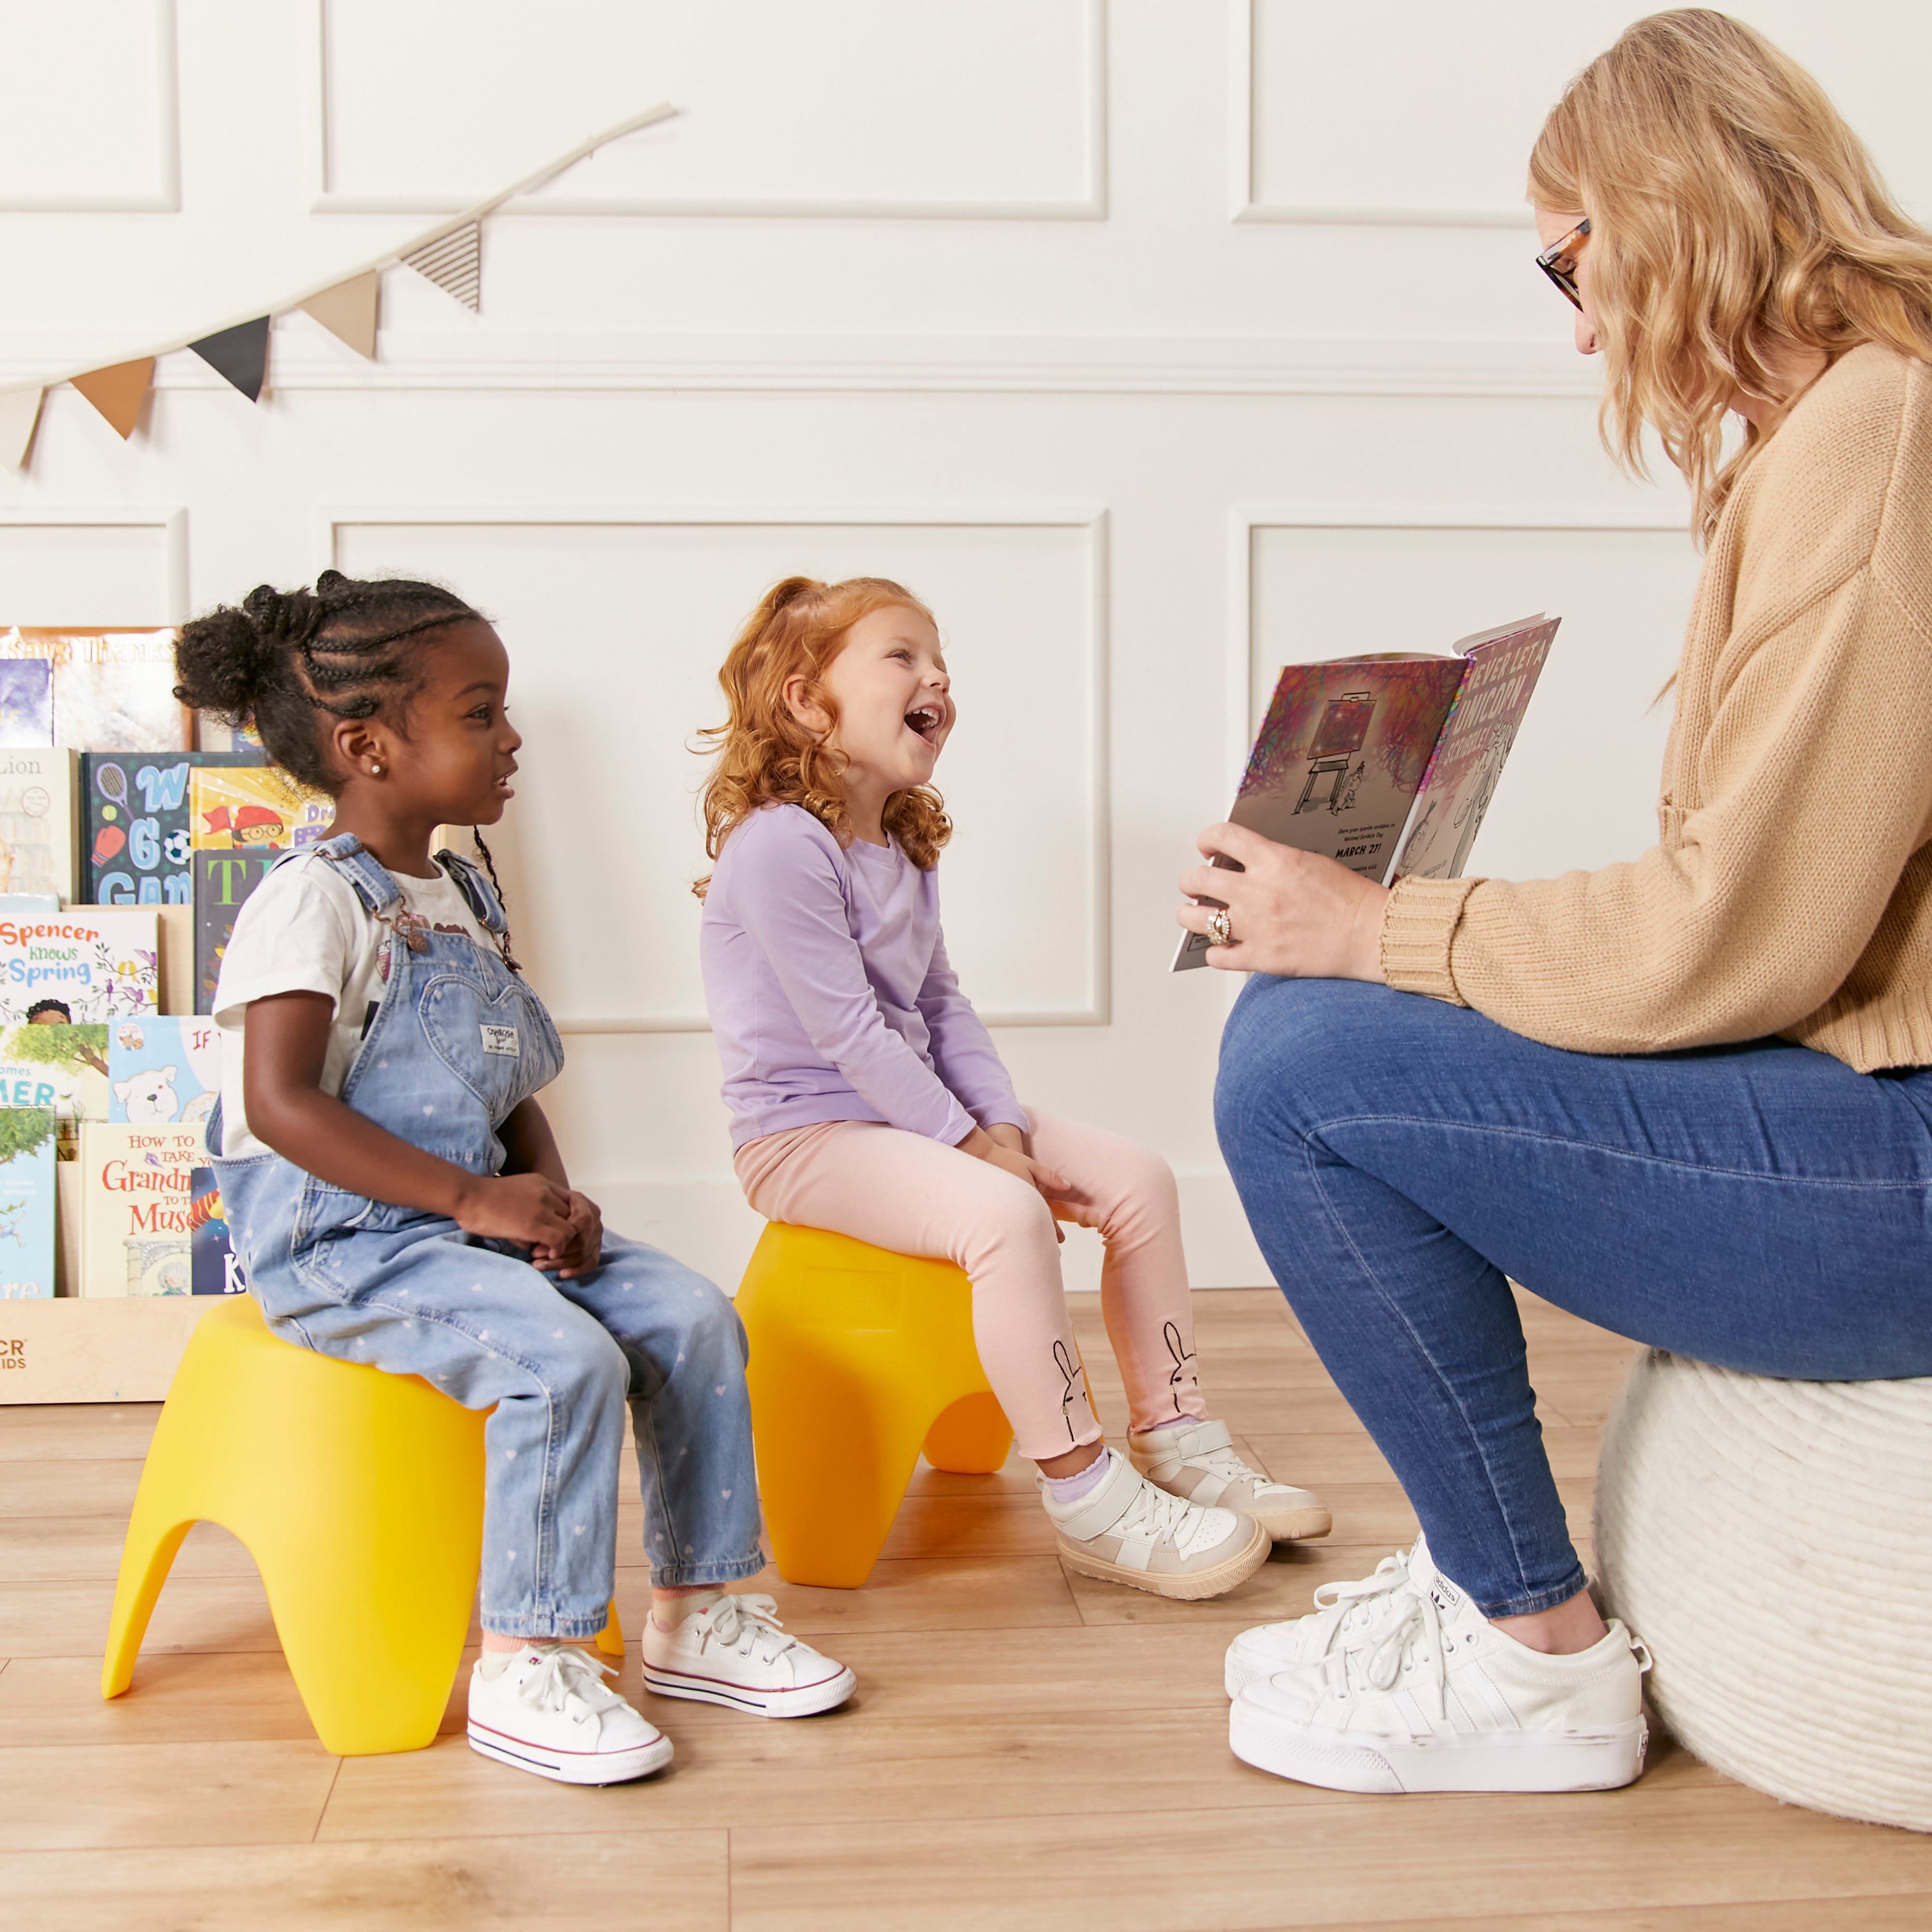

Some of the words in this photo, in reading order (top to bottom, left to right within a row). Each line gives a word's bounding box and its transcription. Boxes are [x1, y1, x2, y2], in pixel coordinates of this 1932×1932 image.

[1467, 652, 1512, 693] NEVER
[1509, 641, 1539, 674] LET
[1533, 639, 1547, 666] A
[1452, 674, 1527, 735] UNICORN
[135, 762, 190, 813] W
[1335, 845, 1367, 858] MARCH
[1368, 842, 1382, 854] 27!
[0, 923, 99, 947] Spencer
[8, 958, 91, 988] Spring
[192, 1030, 212, 1050] IF
[173, 1136, 195, 1148] TO
[161, 1151, 195, 1163] TAKE
[163, 1196, 179, 1205] TO
[0, 1358, 26, 1369] IDS
[1435, 1576, 1455, 1602] adidas
